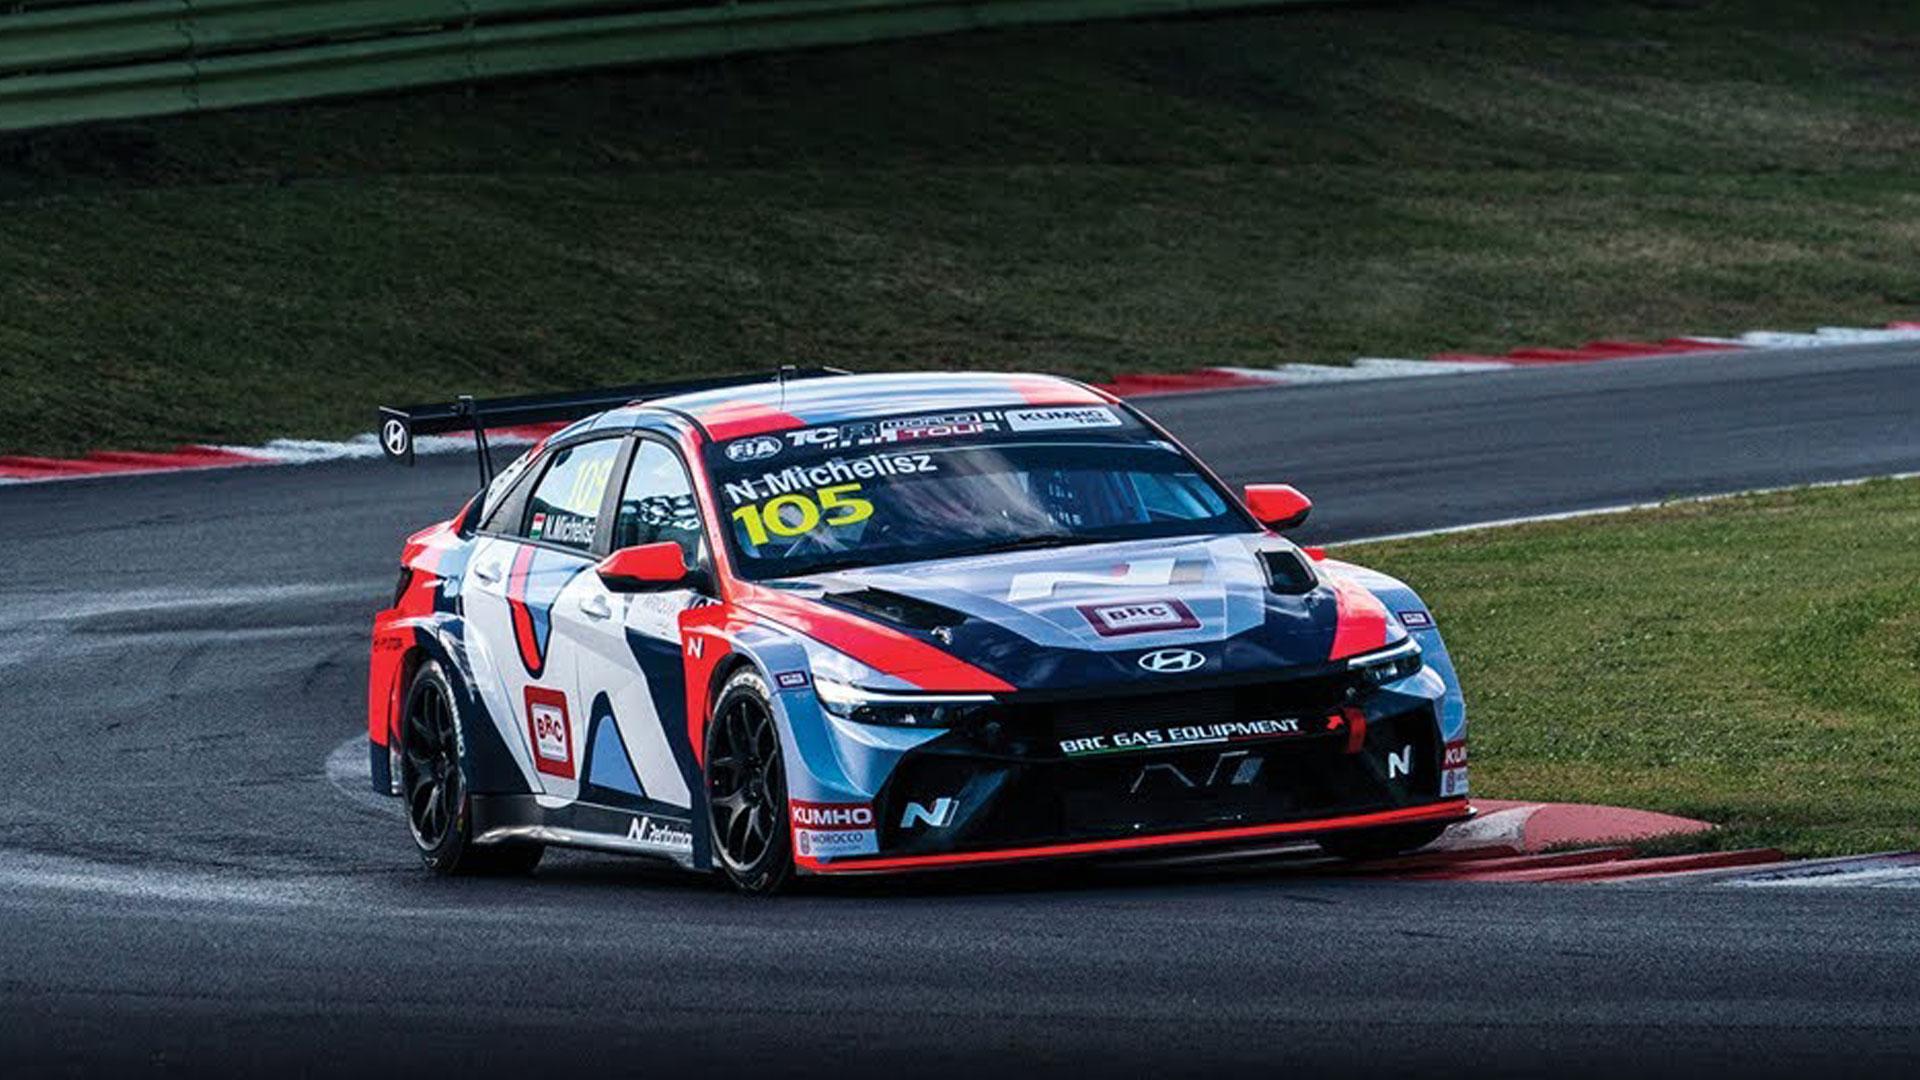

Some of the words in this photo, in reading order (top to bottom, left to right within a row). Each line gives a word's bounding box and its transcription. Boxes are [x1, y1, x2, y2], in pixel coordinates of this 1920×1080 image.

[1018, 410, 1103, 421] KUMHO
[904, 423, 1000, 439] TOUR
[729, 440, 776, 460] FIA
[724, 454, 938, 504] N.Michelisz
[732, 483, 874, 545] 105
[1107, 606, 1167, 621] BRC
[687, 636, 704, 659] N
[536, 713, 563, 743] BRC
[1059, 736, 1109, 753] BRC
[1113, 729, 1163, 747] GAS
[1167, 718, 1300, 742] EQUIPMENT
[1388, 744, 1412, 779] N
[791, 806, 873, 825] KUMHO
[900, 797, 952, 828] N
[626, 816, 649, 842] N
[811, 831, 864, 845] MOROCCO
